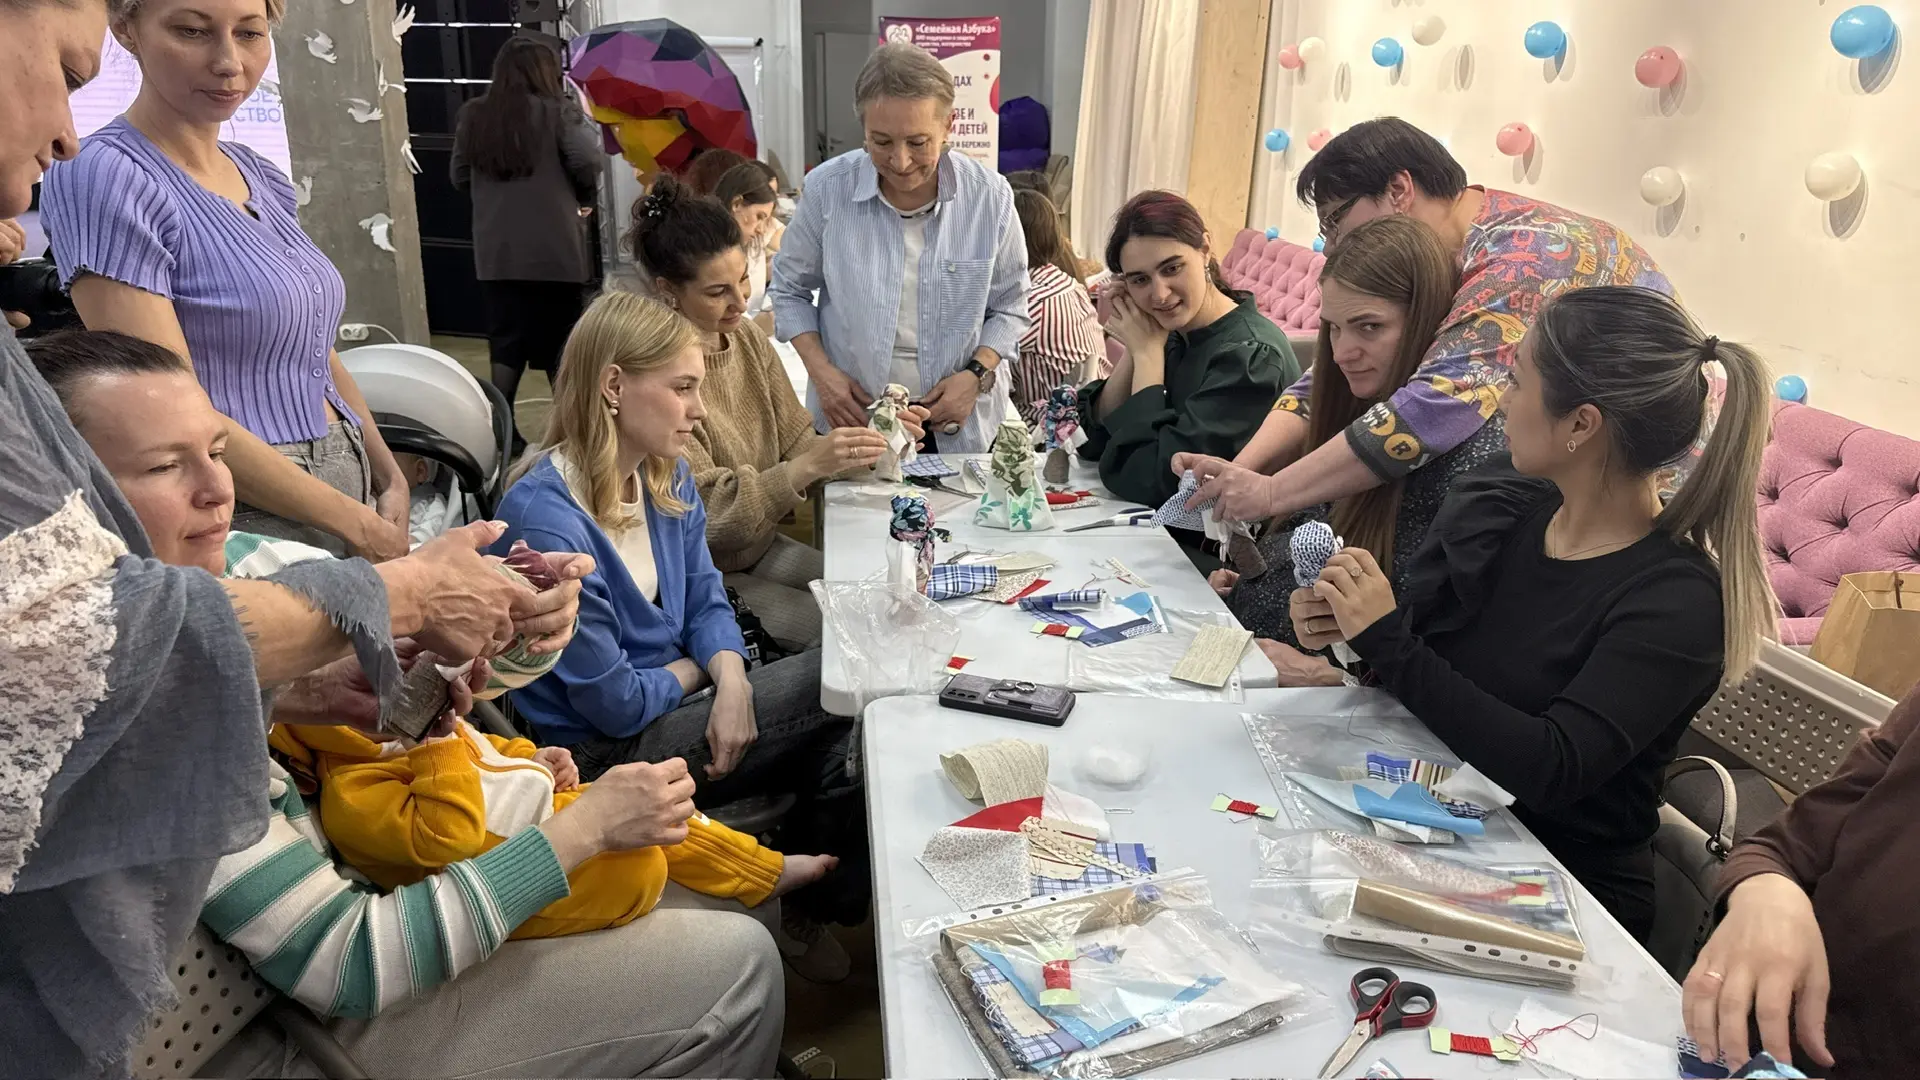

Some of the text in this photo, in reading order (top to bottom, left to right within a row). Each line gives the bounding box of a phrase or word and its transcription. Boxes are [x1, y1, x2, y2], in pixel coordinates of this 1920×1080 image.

[954, 76, 972, 87] ДАХ
[234, 107, 281, 122] СТВО
[955, 108, 966, 120] ЗЕ
[958, 122, 988, 136] ДЕТЕЙ
[1391, 440, 1412, 456] R
